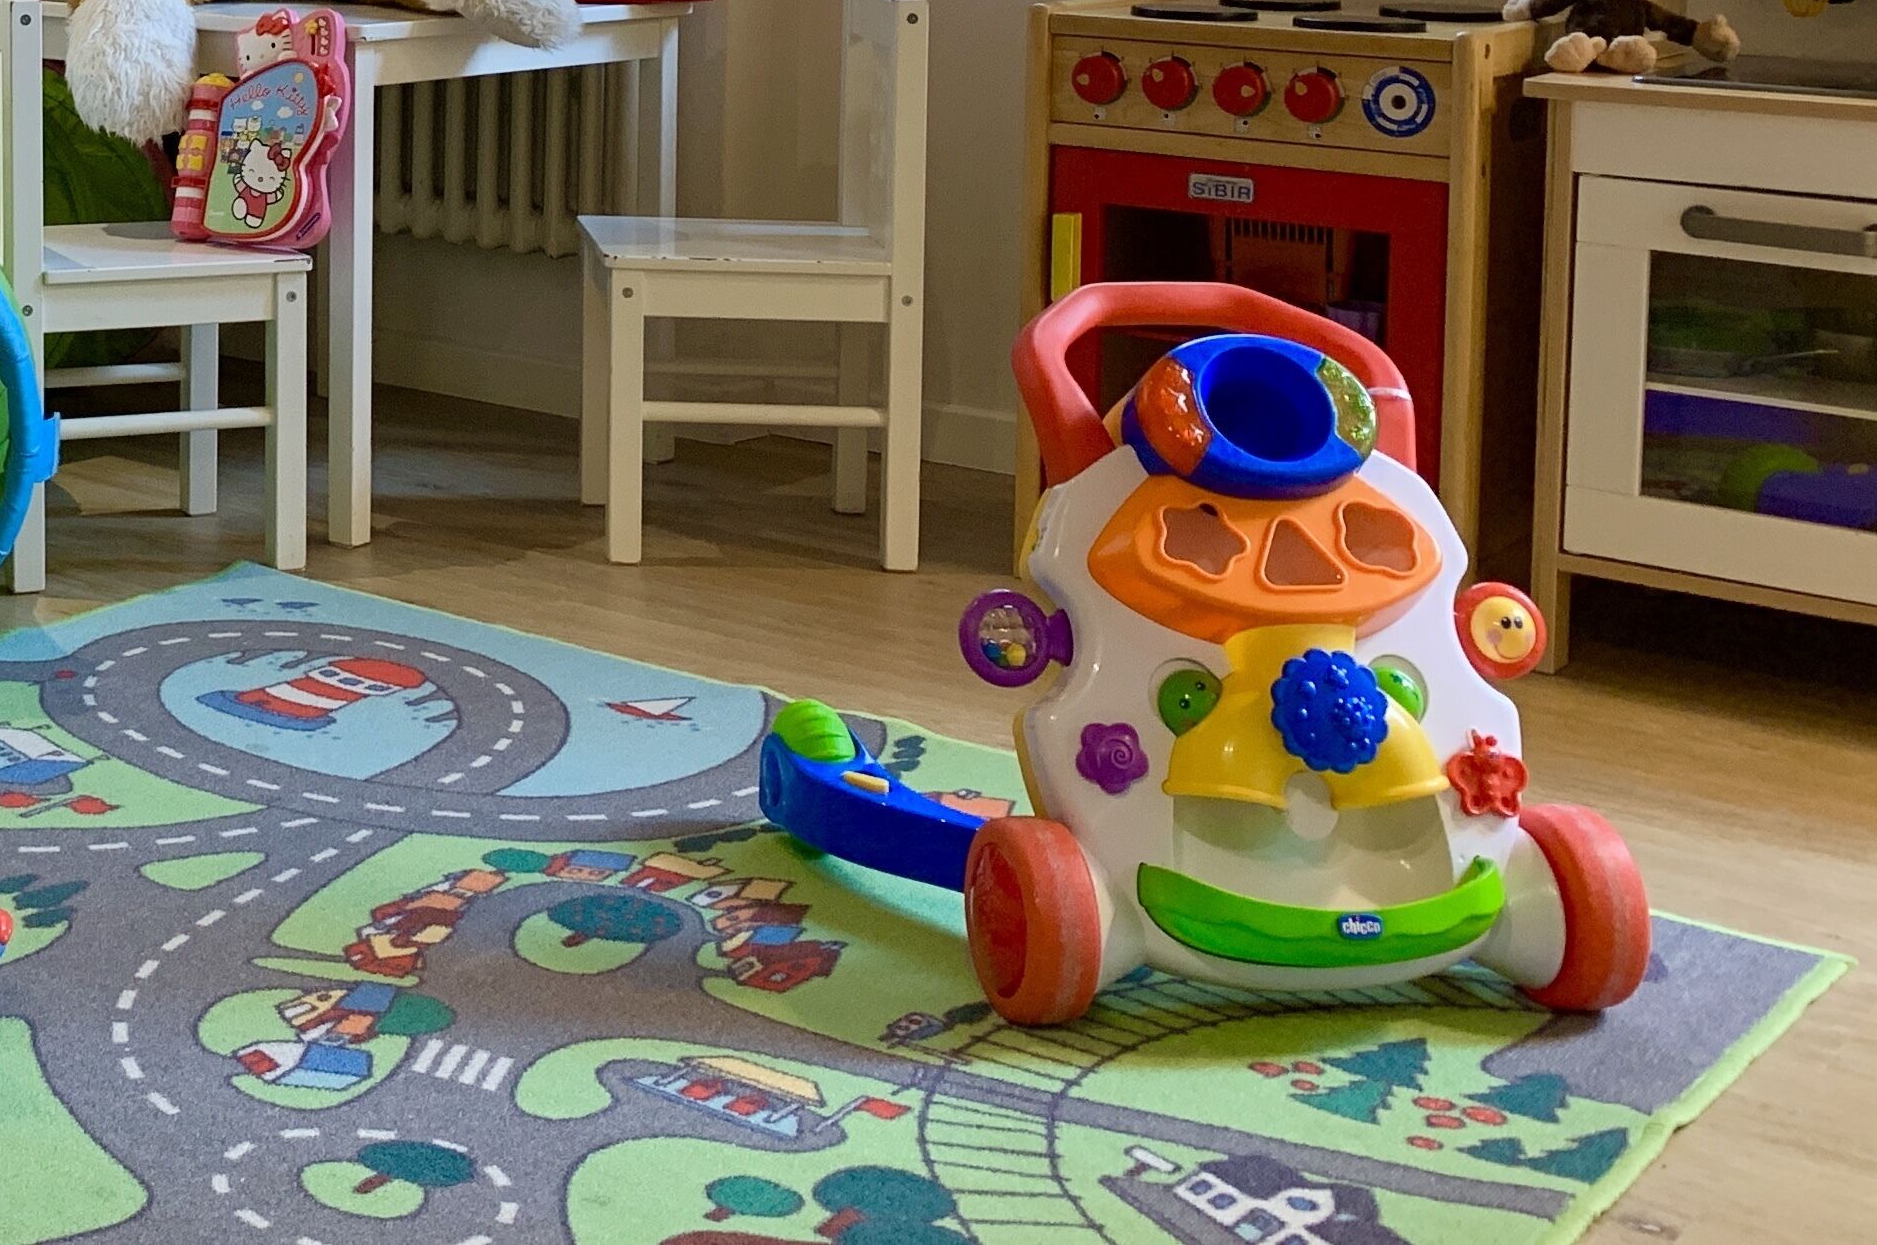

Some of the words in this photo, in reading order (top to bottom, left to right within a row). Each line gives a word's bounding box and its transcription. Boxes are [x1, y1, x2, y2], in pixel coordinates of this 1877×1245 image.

[229, 83, 272, 109] Hello
[276, 83, 309, 115] Kitty
[1342, 916, 1381, 935] chicco
